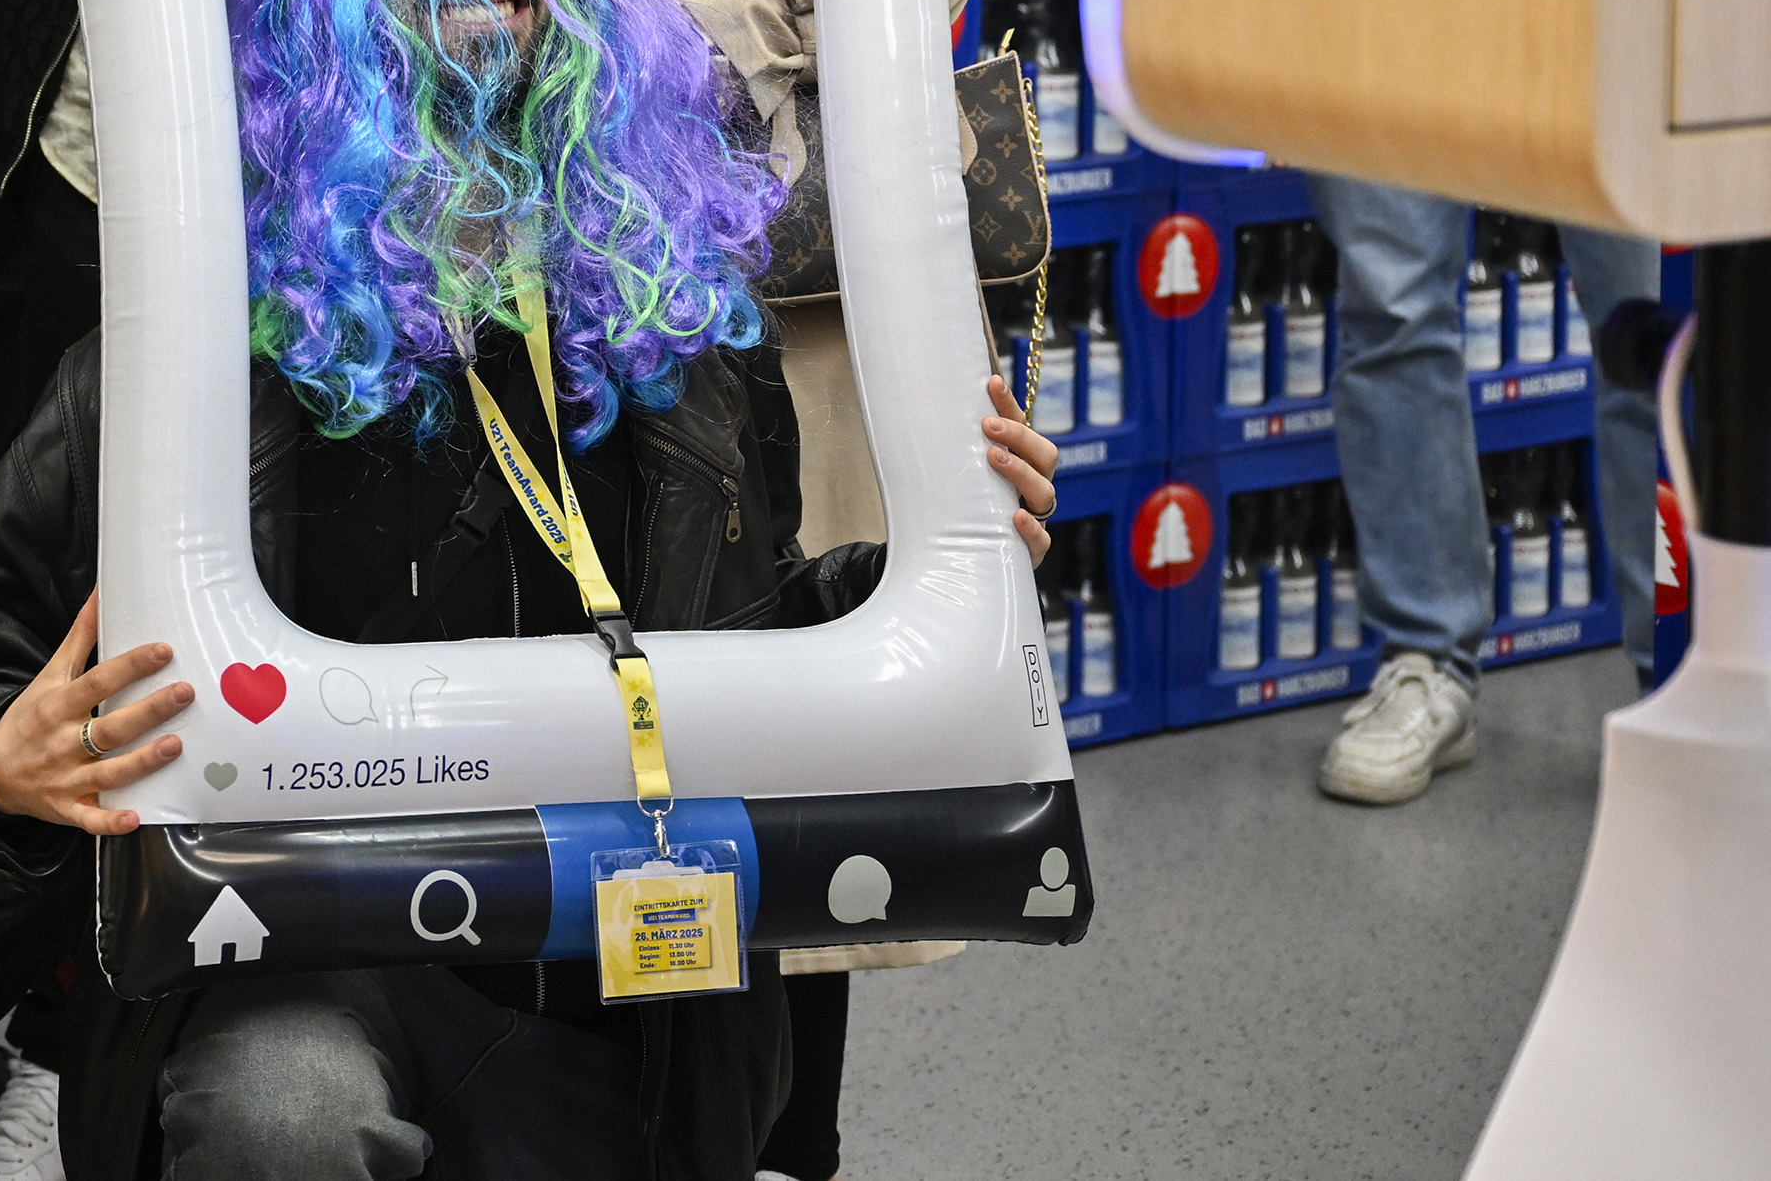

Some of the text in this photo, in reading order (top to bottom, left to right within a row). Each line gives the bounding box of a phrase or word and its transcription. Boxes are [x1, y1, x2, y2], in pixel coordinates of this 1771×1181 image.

[489, 418, 567, 545] U21 TeamAward 2025
[1027, 651, 1044, 720] DOIY
[261, 755, 490, 792] 1.253.025 Likes
[633, 898, 704, 912] EINTRITTSKARTE ZUM
[657, 912, 691, 920] TEAMAWARD
[635, 928, 703, 941] 26. MÄRZ 2025
